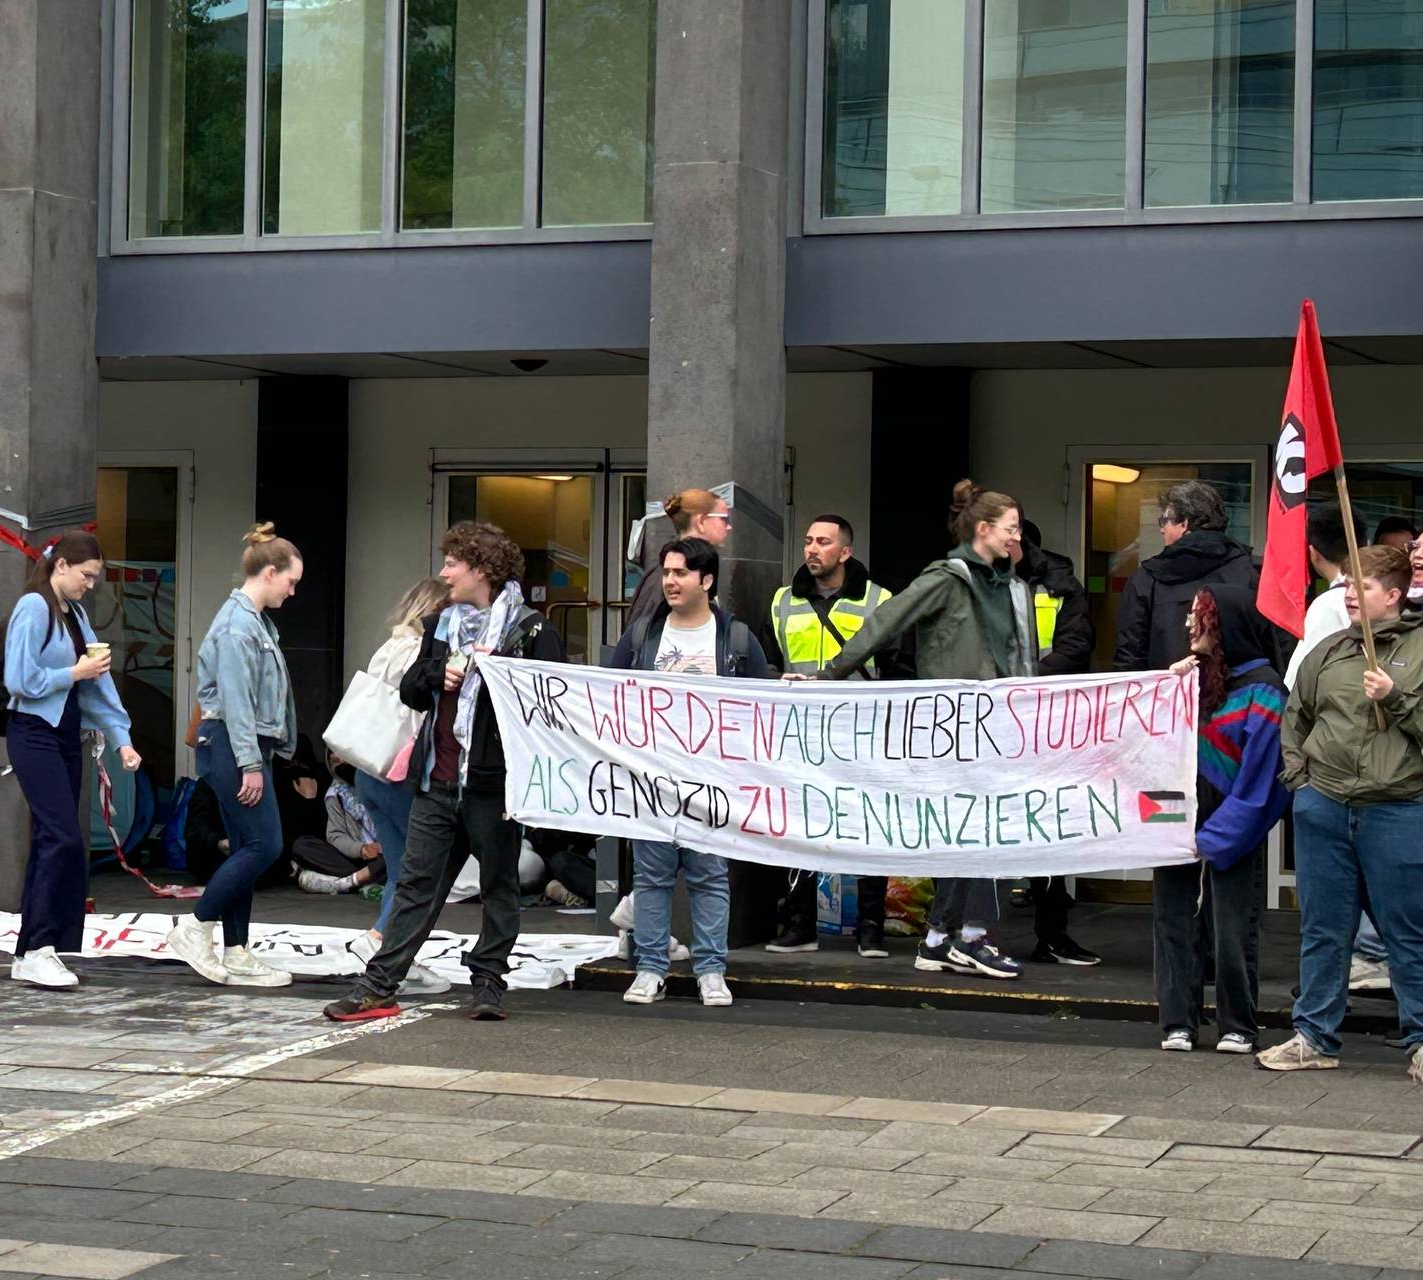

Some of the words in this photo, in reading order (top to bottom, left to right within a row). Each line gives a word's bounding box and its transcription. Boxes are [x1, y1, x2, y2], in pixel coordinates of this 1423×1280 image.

[507, 667, 580, 737] WIR
[586, 678, 776, 762] WÜRDEN
[777, 699, 878, 766] AUCH
[883, 692, 1002, 762] LIEBER
[1005, 668, 1196, 760] STUDIEREN
[522, 754, 580, 816] ALS
[587, 759, 730, 830] GENOZID
[739, 785, 789, 838] ZU
[802, 778, 1123, 850] DENUNZIEREN
